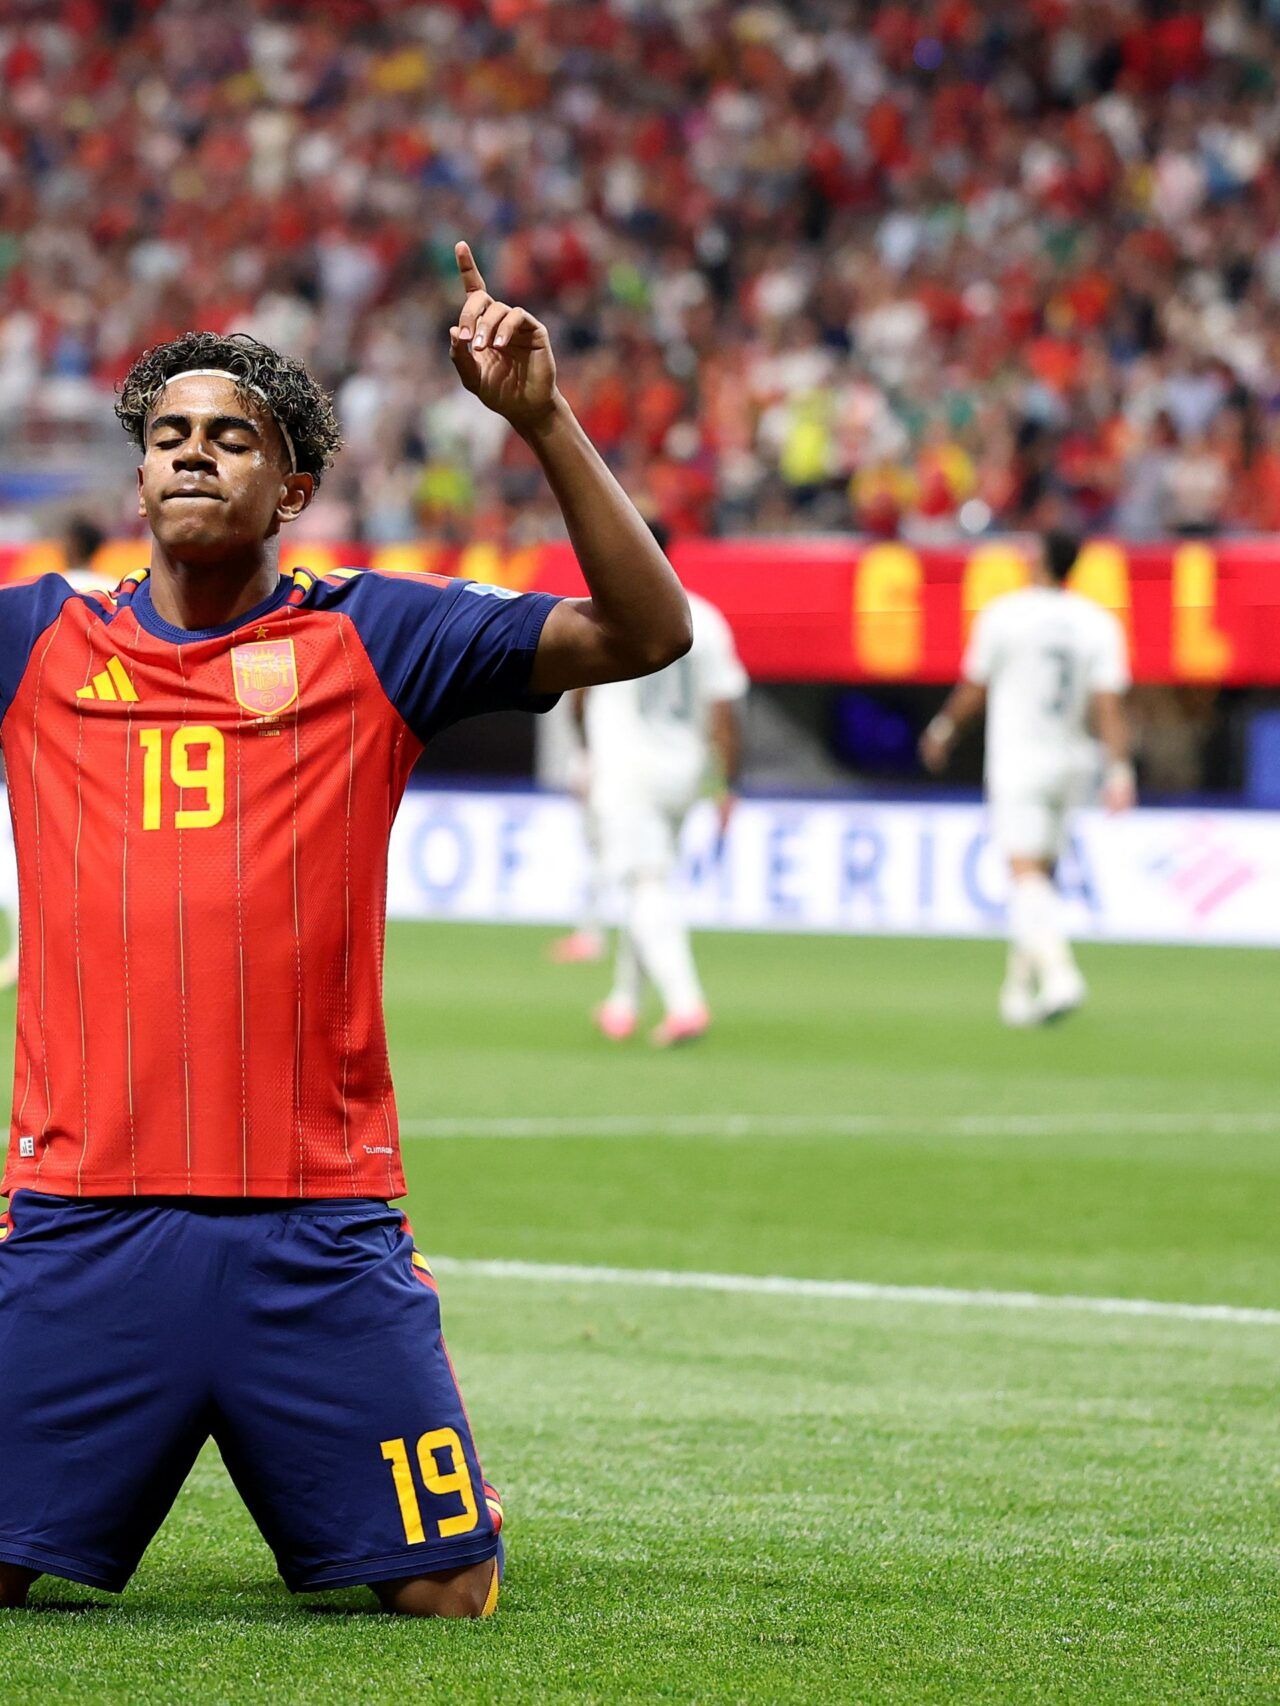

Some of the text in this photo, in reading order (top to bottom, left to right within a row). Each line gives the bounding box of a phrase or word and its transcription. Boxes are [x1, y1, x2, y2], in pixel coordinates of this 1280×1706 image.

[138, 724, 226, 832] 19
[405, 813, 1104, 916] OF MERICA
[380, 1426, 480, 1545] 19
